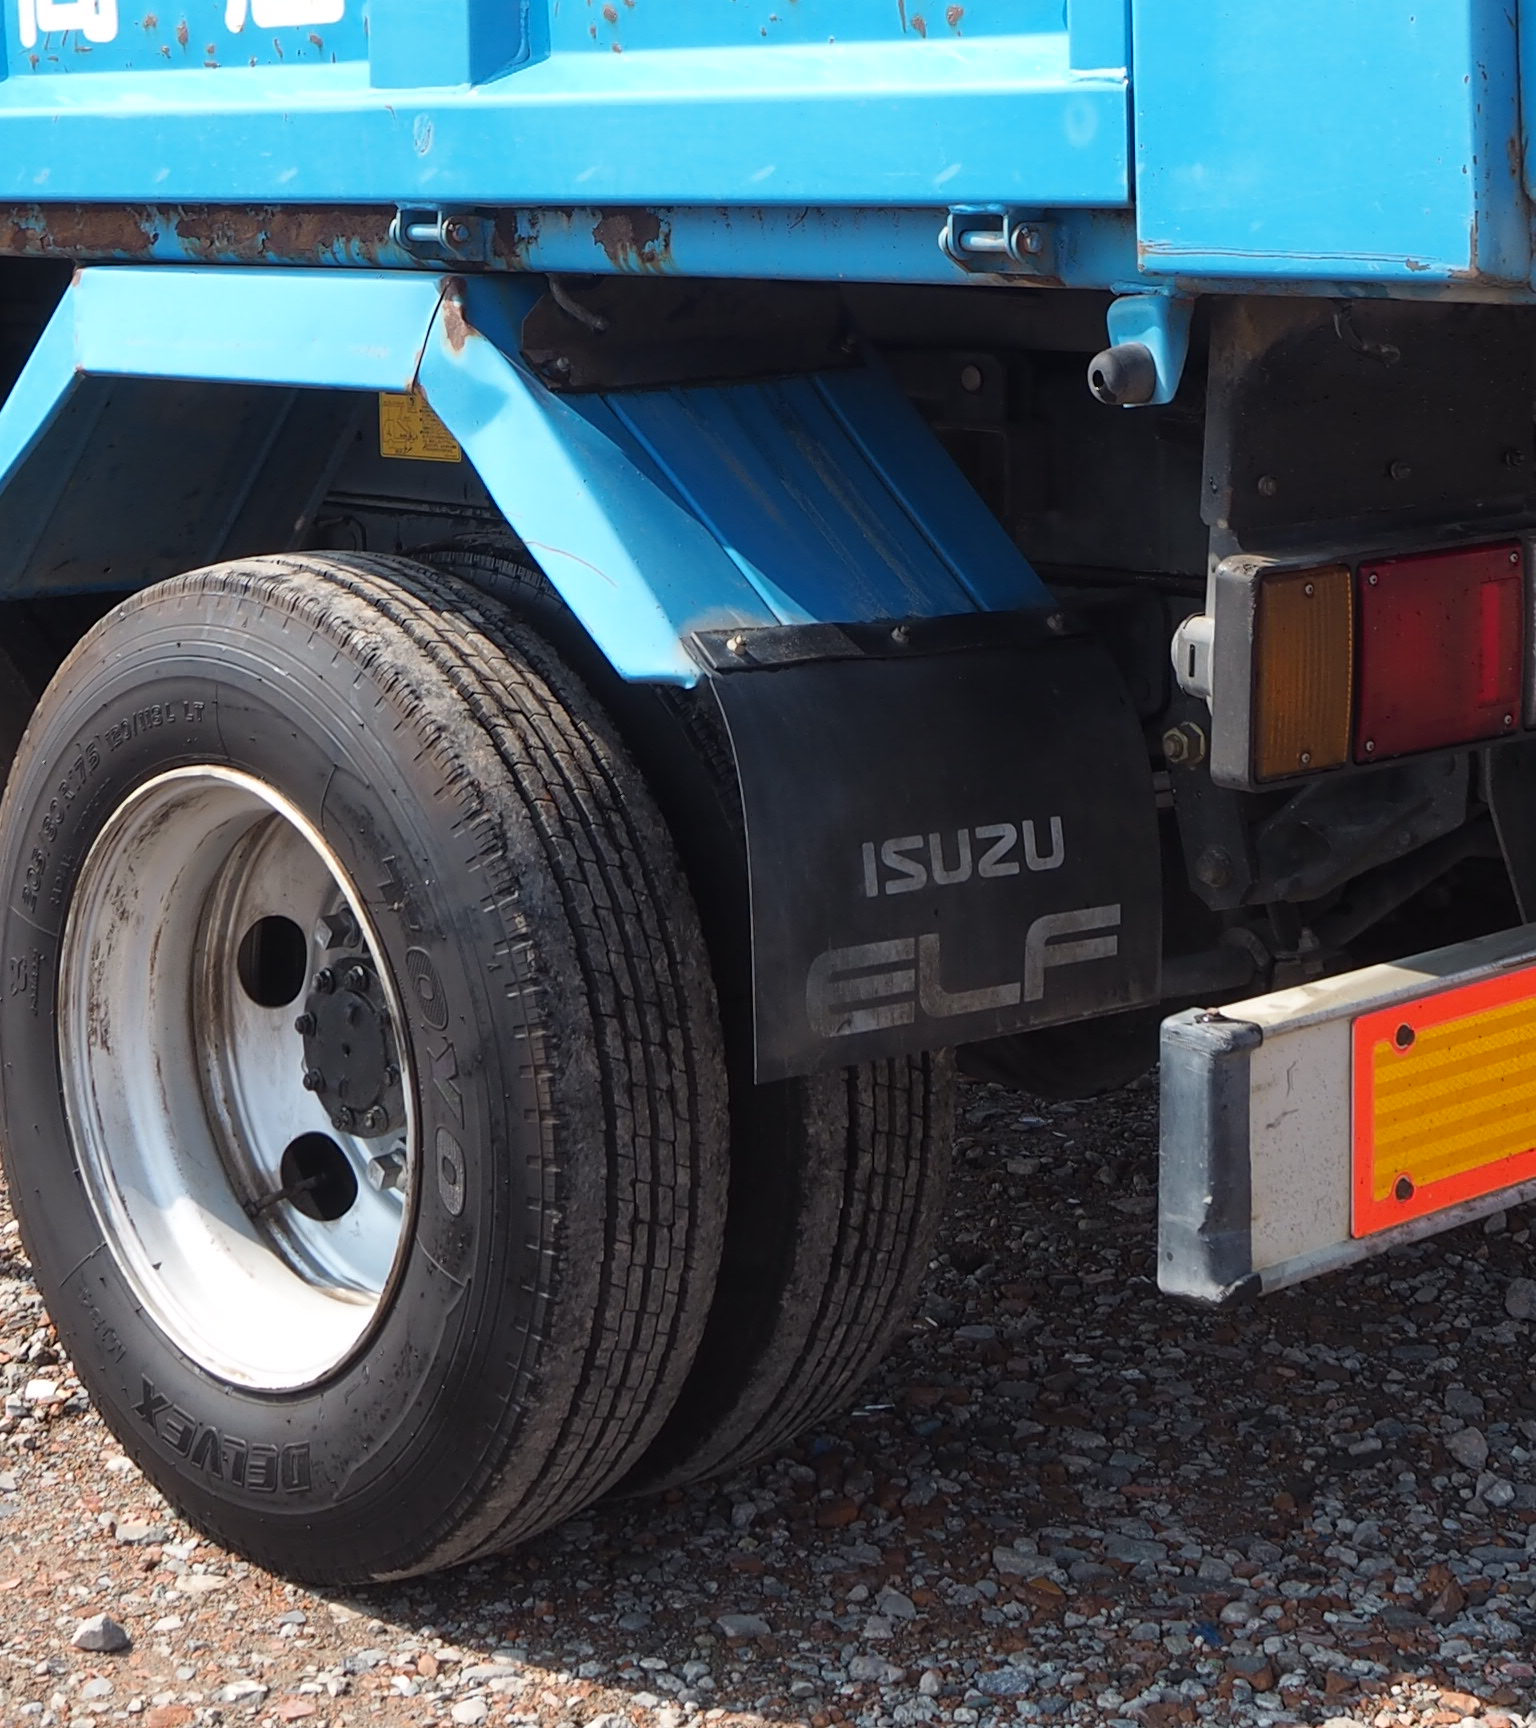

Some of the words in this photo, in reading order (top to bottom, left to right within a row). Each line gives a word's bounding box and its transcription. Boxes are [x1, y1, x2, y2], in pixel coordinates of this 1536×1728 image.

[861, 815, 1065, 898] ISUZU
[805, 903, 1122, 1039] ELF
[130, 1372, 313, 1495] DELVEX
